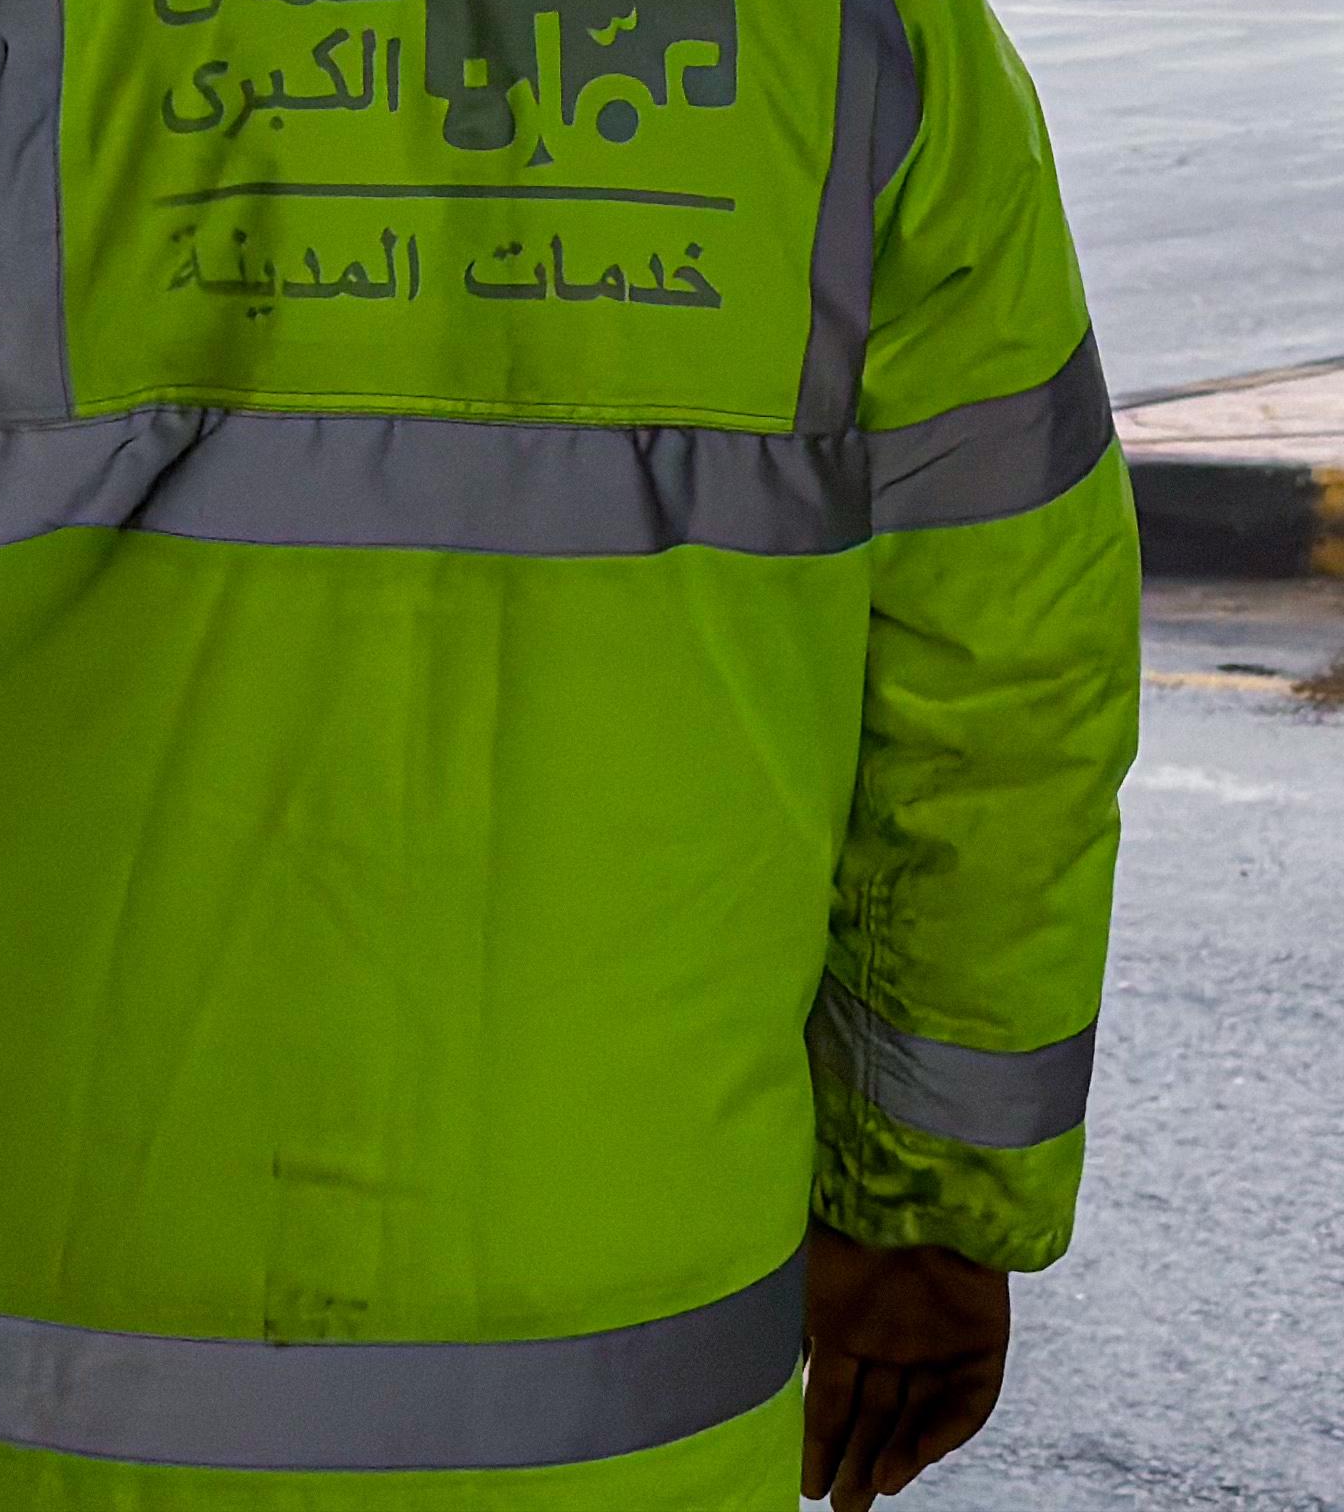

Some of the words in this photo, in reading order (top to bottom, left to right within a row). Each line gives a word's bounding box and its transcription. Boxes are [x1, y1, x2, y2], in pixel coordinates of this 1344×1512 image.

[161, 28, 401, 138] الكبرى
[168, 226, 420, 319] المدينة
[463, 233, 722, 309] خدمات
